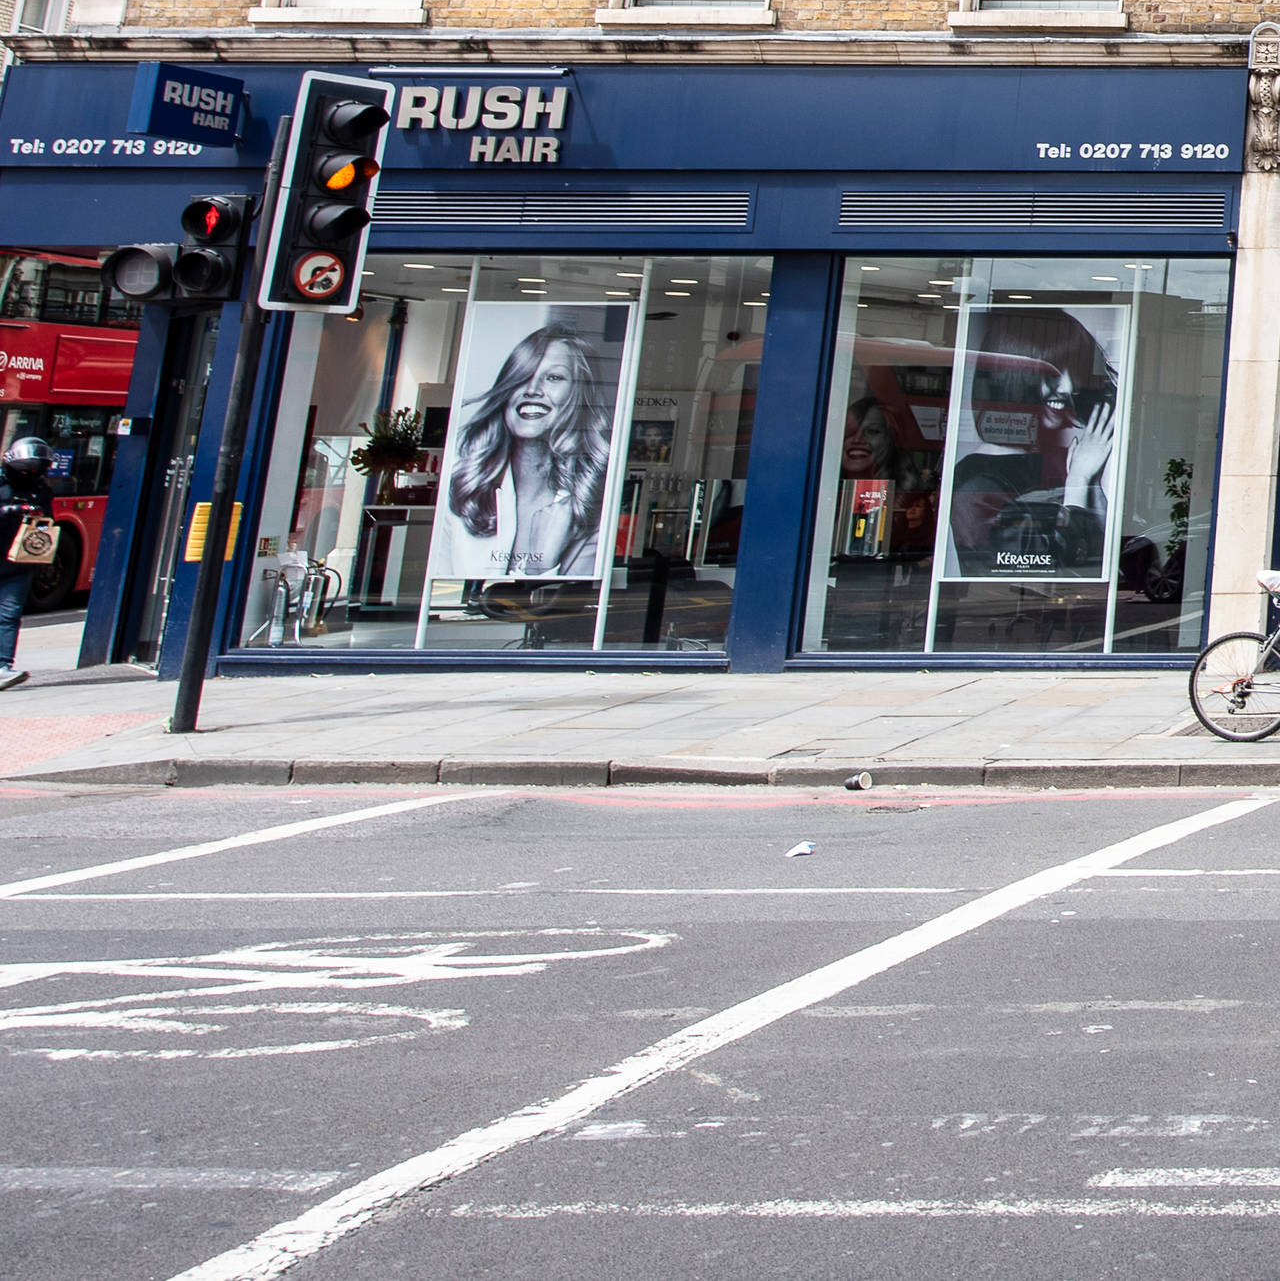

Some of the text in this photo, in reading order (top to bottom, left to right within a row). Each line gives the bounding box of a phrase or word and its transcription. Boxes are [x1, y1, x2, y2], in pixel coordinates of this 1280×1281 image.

[163, 80, 234, 114] RUSH
[396, 86, 568, 130] RUSH
[192, 112, 230, 131] HAIR
[10, 138, 203, 155] Tel: 0207 713 9120
[469, 136, 561, 163] HAIR
[1036, 143, 1230, 159] Tel: 0207 713 9120
[8, 355, 44, 371] ARRIVA
[635, 398, 678, 406] REDKEN
[996, 551, 1052, 565] KÉRASTASE
